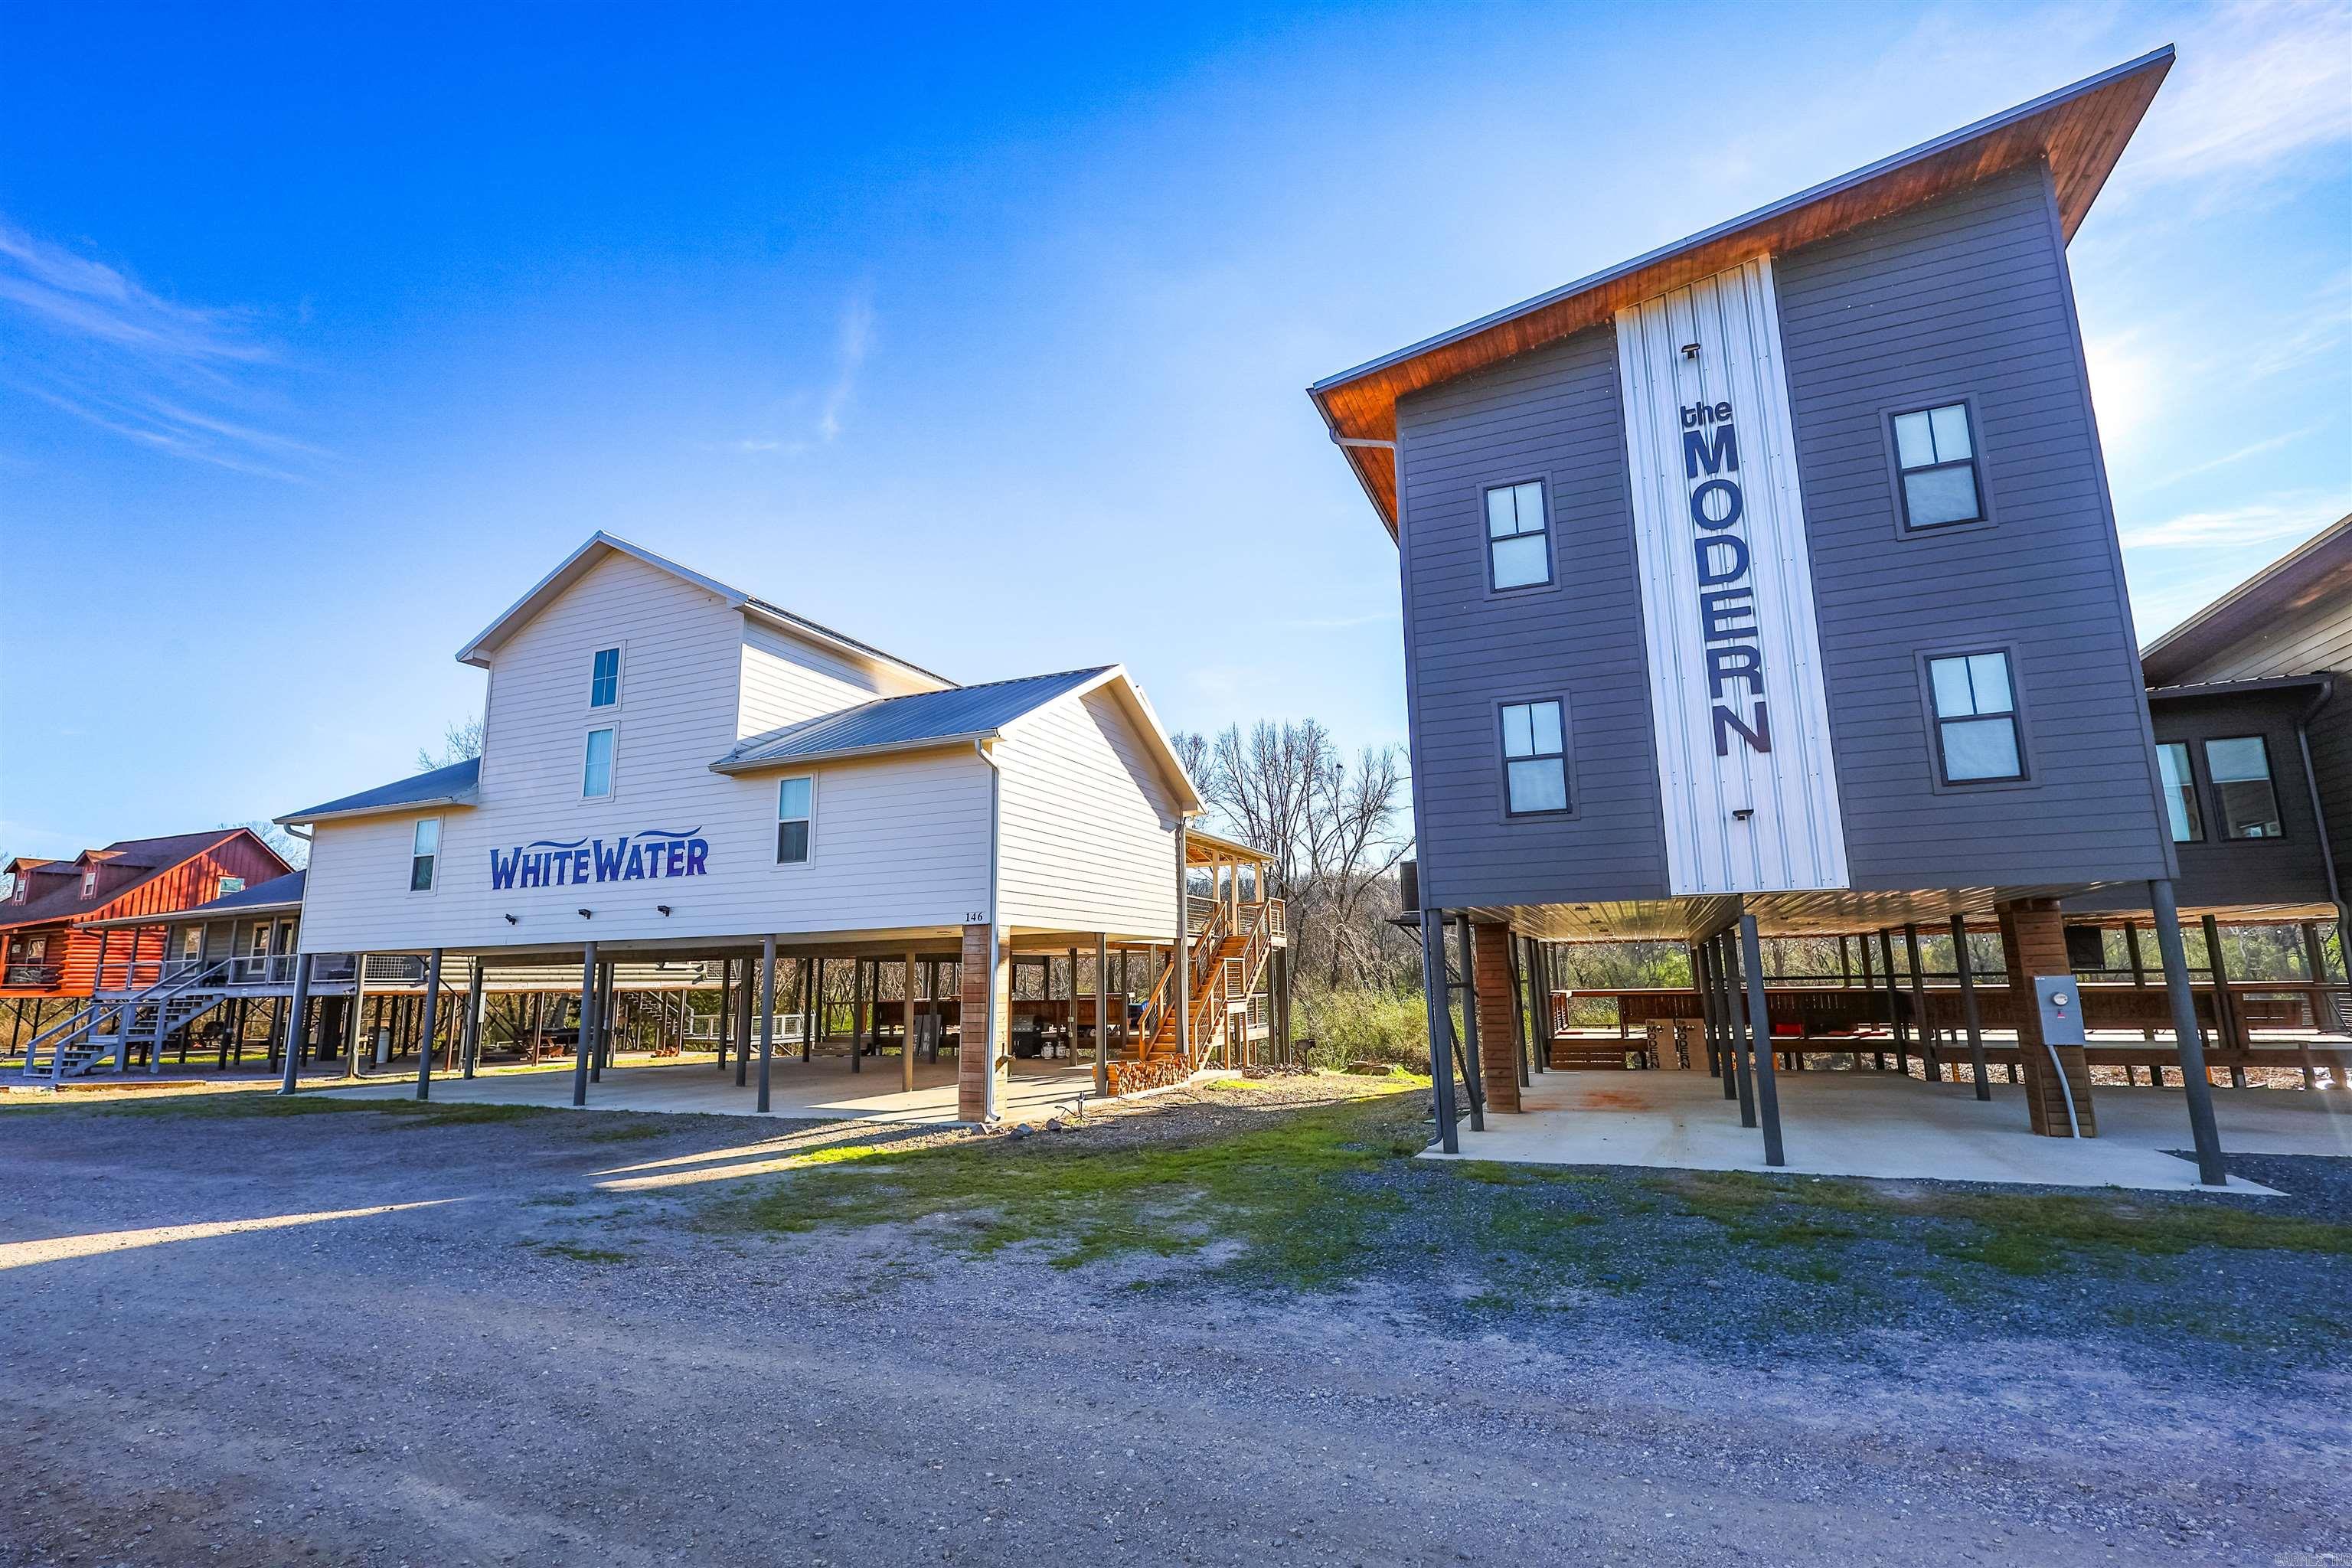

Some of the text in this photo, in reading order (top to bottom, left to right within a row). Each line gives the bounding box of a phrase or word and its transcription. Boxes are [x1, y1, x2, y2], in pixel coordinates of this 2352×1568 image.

[1680, 401, 1733, 428] the
[1684, 423, 1772, 756] MODERN
[965, 911, 984, 923] 146
[1647, 1026, 1660, 1069] MODERN
[1677, 1026, 1690, 1069] MODERN
